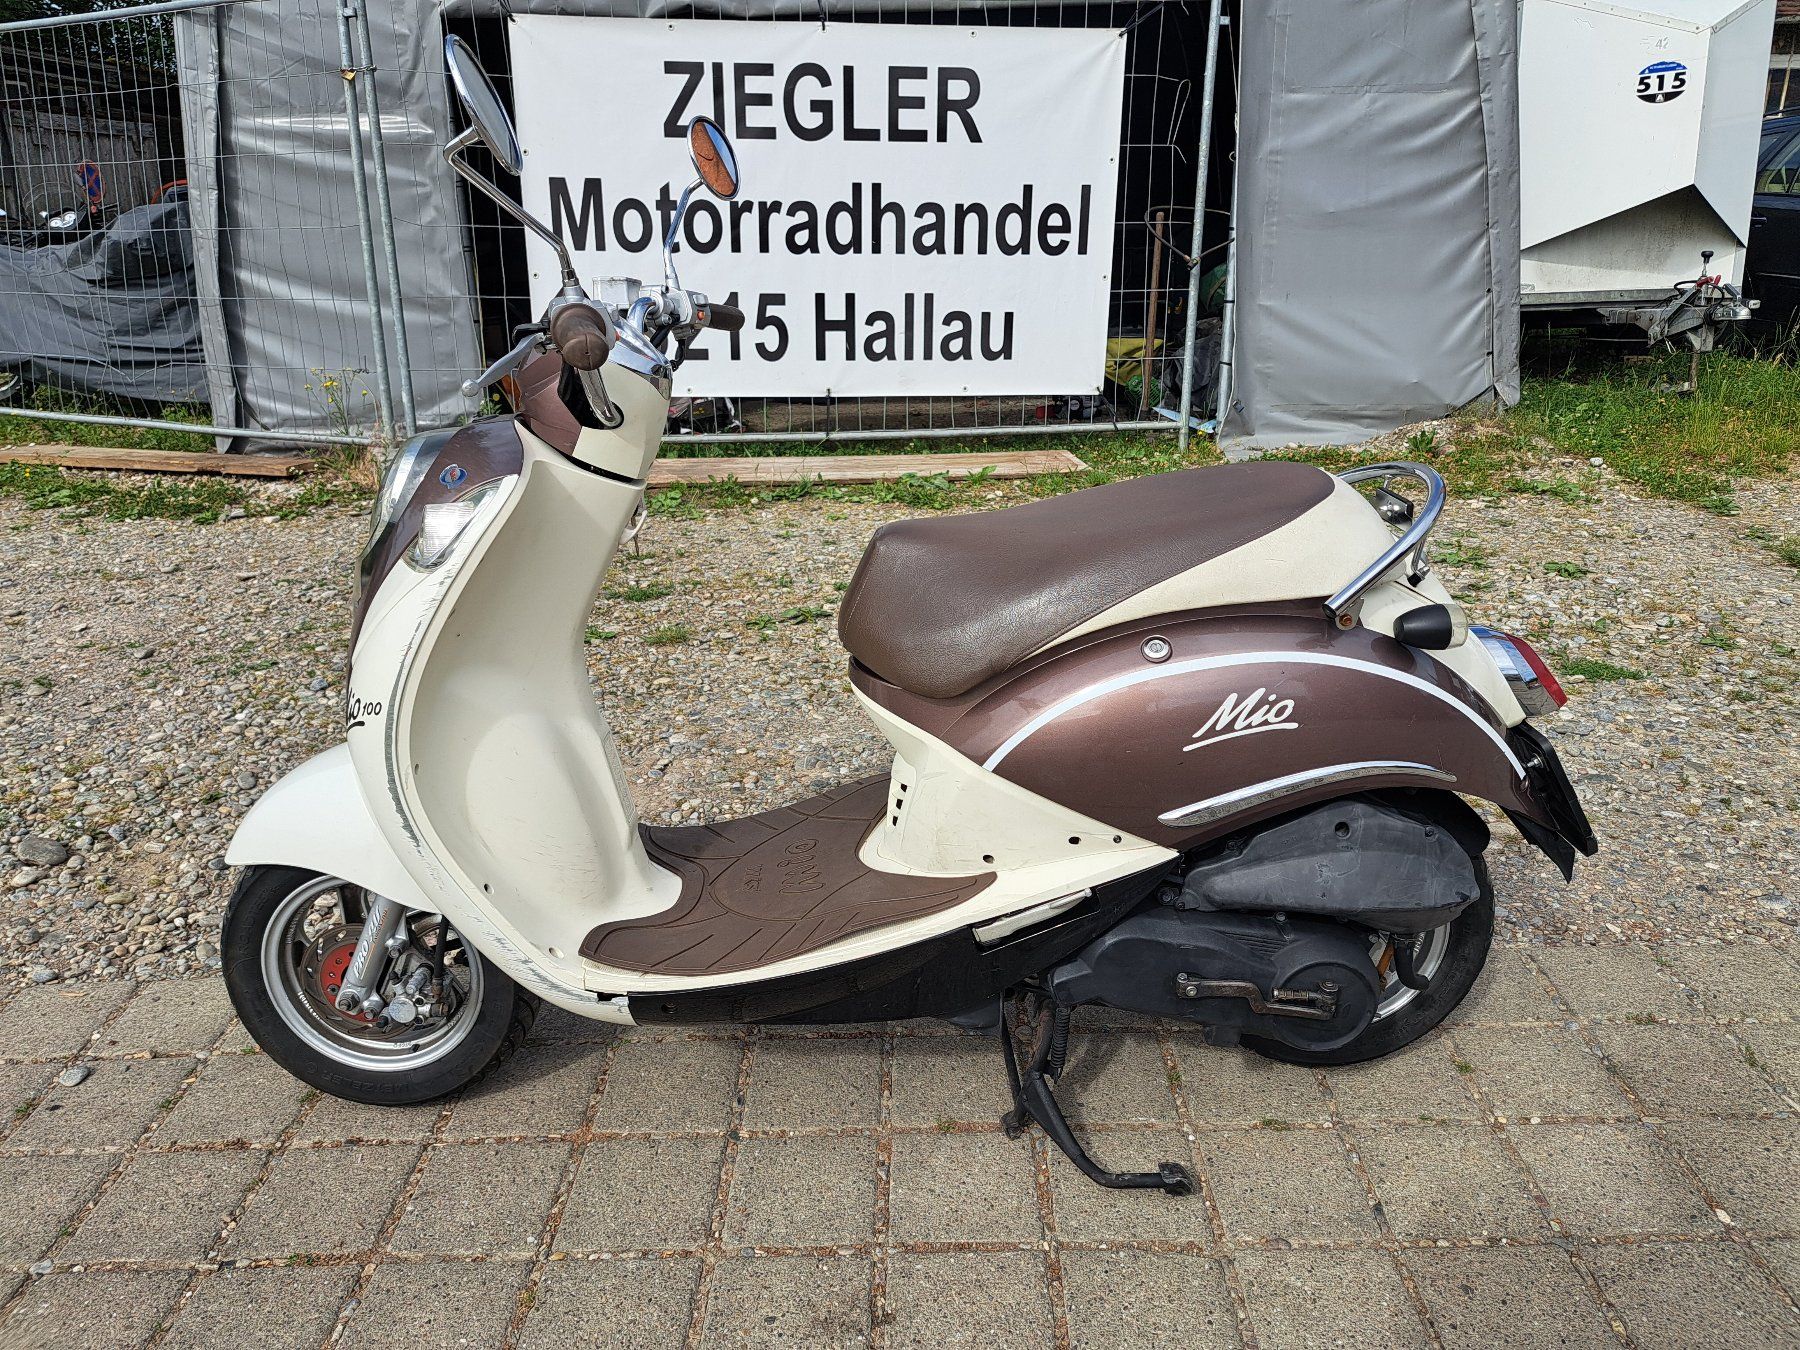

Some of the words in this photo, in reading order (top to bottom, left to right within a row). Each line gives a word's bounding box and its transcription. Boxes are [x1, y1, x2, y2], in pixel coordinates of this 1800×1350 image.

[663, 60, 983, 143] ZIEGLER
[1636, 71, 1687, 93] 515
[548, 176, 1091, 257] Motorradhandel
[814, 292, 1014, 363] Hallau
[362, 702, 382, 716] 100
[1187, 687, 1297, 744] Mio
